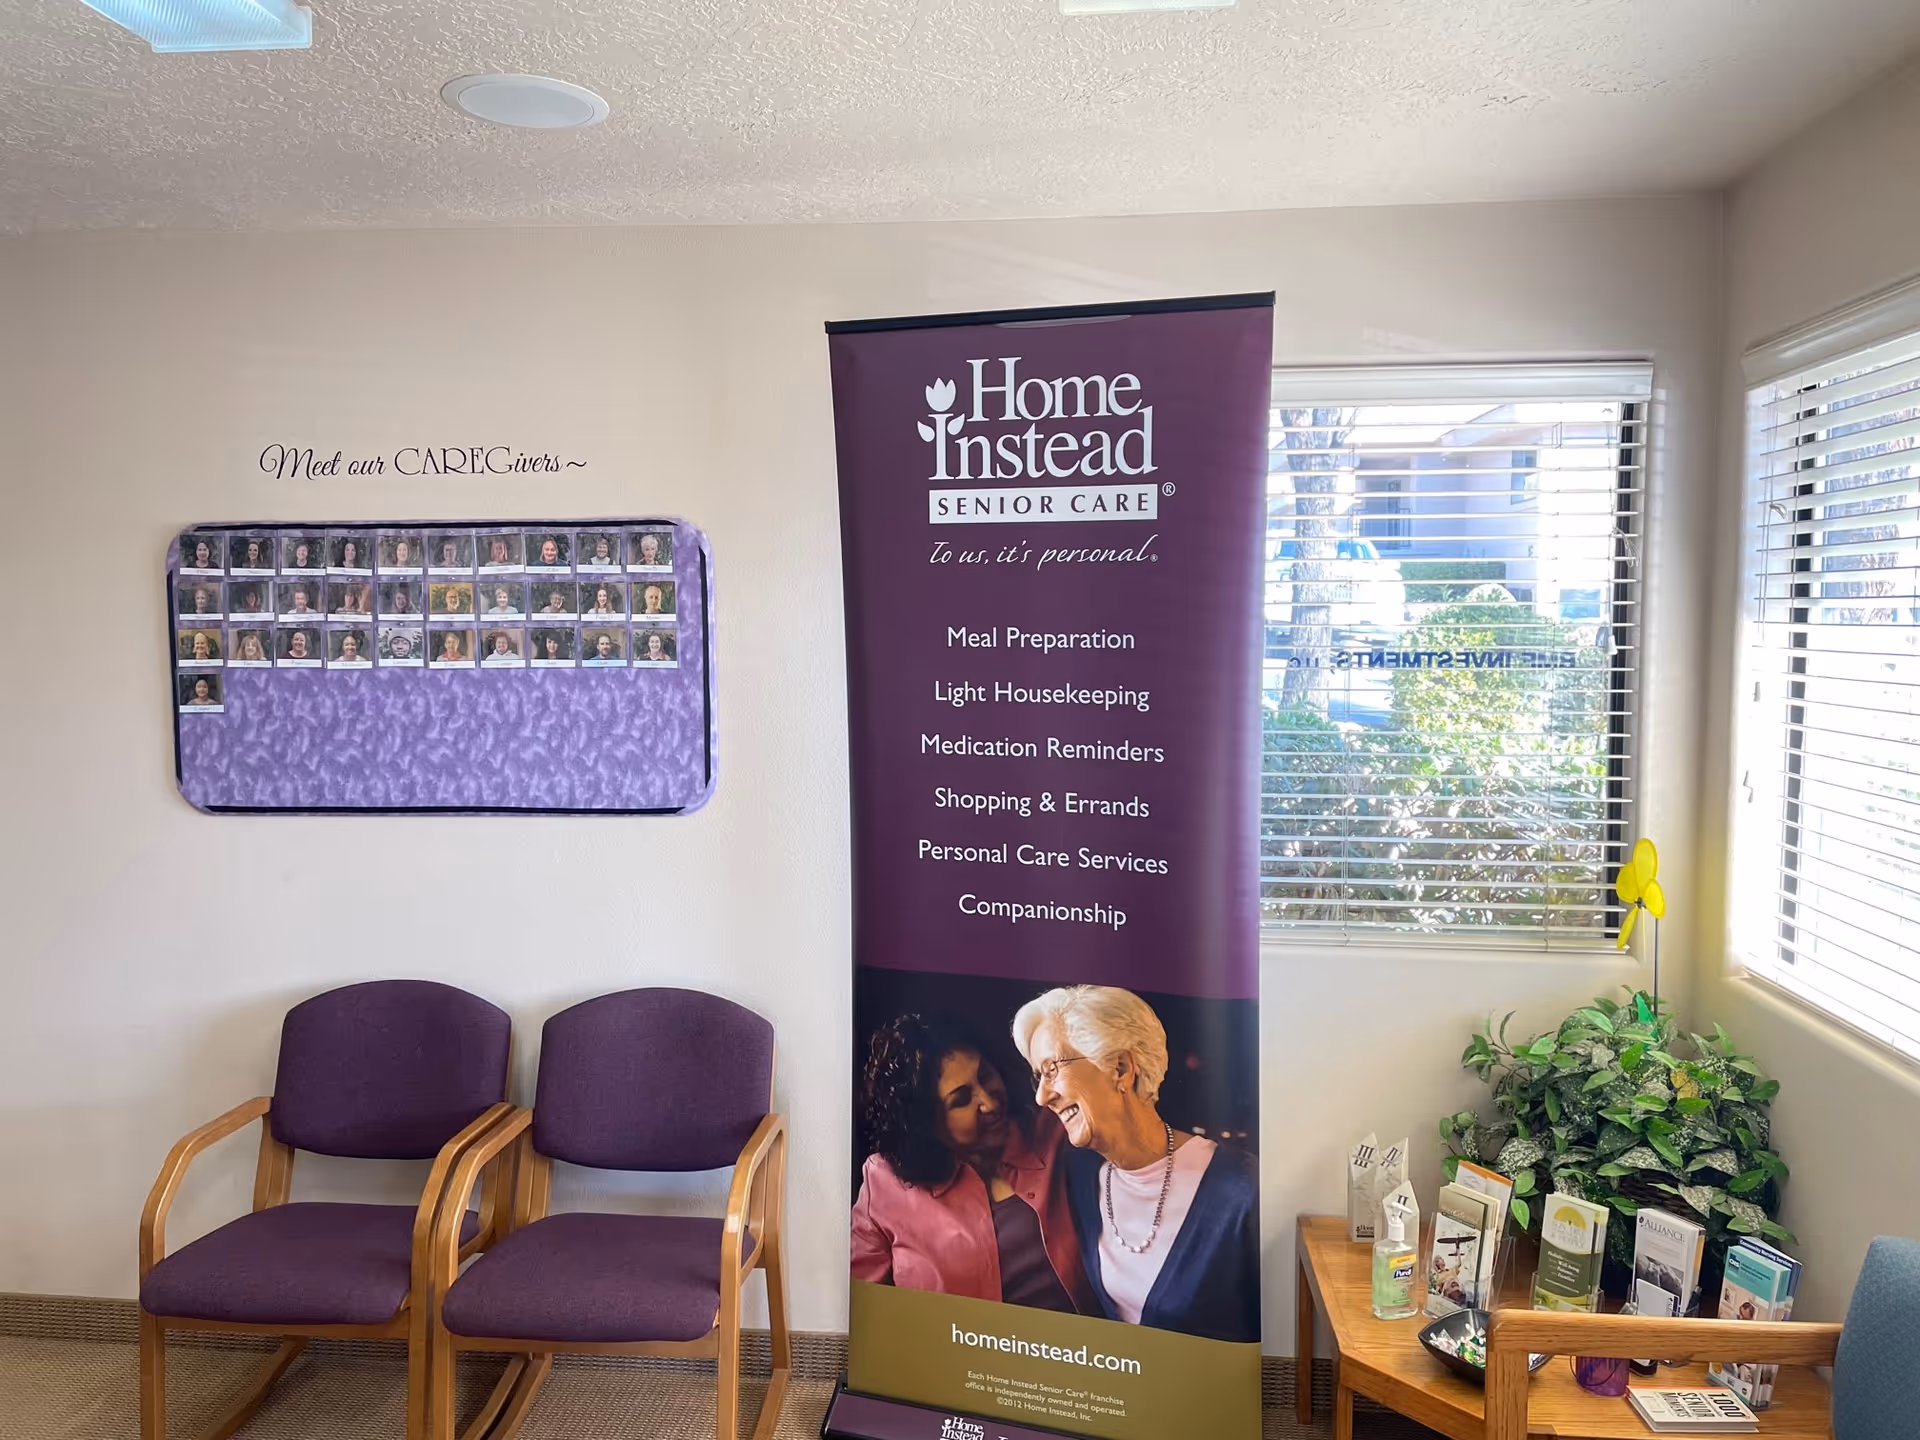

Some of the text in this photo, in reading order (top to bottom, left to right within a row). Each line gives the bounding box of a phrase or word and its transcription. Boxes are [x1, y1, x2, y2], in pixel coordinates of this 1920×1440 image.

[966, 357, 1142, 421] Home
[928, 406, 1158, 480] Instead
[259, 443, 342, 481] Meet
[348, 456, 386, 476] our
[938, 495, 1054, 516] SENIOR
[1070, 493, 1149, 514] CARE
[929, 541, 952, 564] To
[958, 549, 989, 565] us,
[996, 540, 1032, 564] it's
[947, 626, 1135, 654] Meal Preparation
[934, 680, 1150, 712] Light Housekeeping
[921, 733, 1165, 762] Medication Reminders
[934, 787, 1150, 818] Shopping & Errands
[918, 839, 1169, 874] Personal Care Services
[958, 893, 1127, 931] Companionship
[1644, 1218, 1685, 1243] ALLIANCE
[951, 1323, 1141, 1374] homeinstead.com
[965, 1381, 1127, 1417] office is independently owned and operated.
[967, 1371, 985, 1380] Each
[986, 1374, 1009, 1385] Home
[1011, 1378, 1038, 1389] Instead
[1039, 1384, 1063, 1394] Senior
[1090, 1392, 1125, 1405] franchise
[1024, 1402, 1047, 1413] Home
[1049, 1406, 1078, 1420] Instead,
[1079, 1413, 1093, 1422] Inc.
[1677, 1391, 1716, 1418] SENIOR
[941, 1427, 985, 1440] Instead
[952, 1416, 983, 1433] Home
